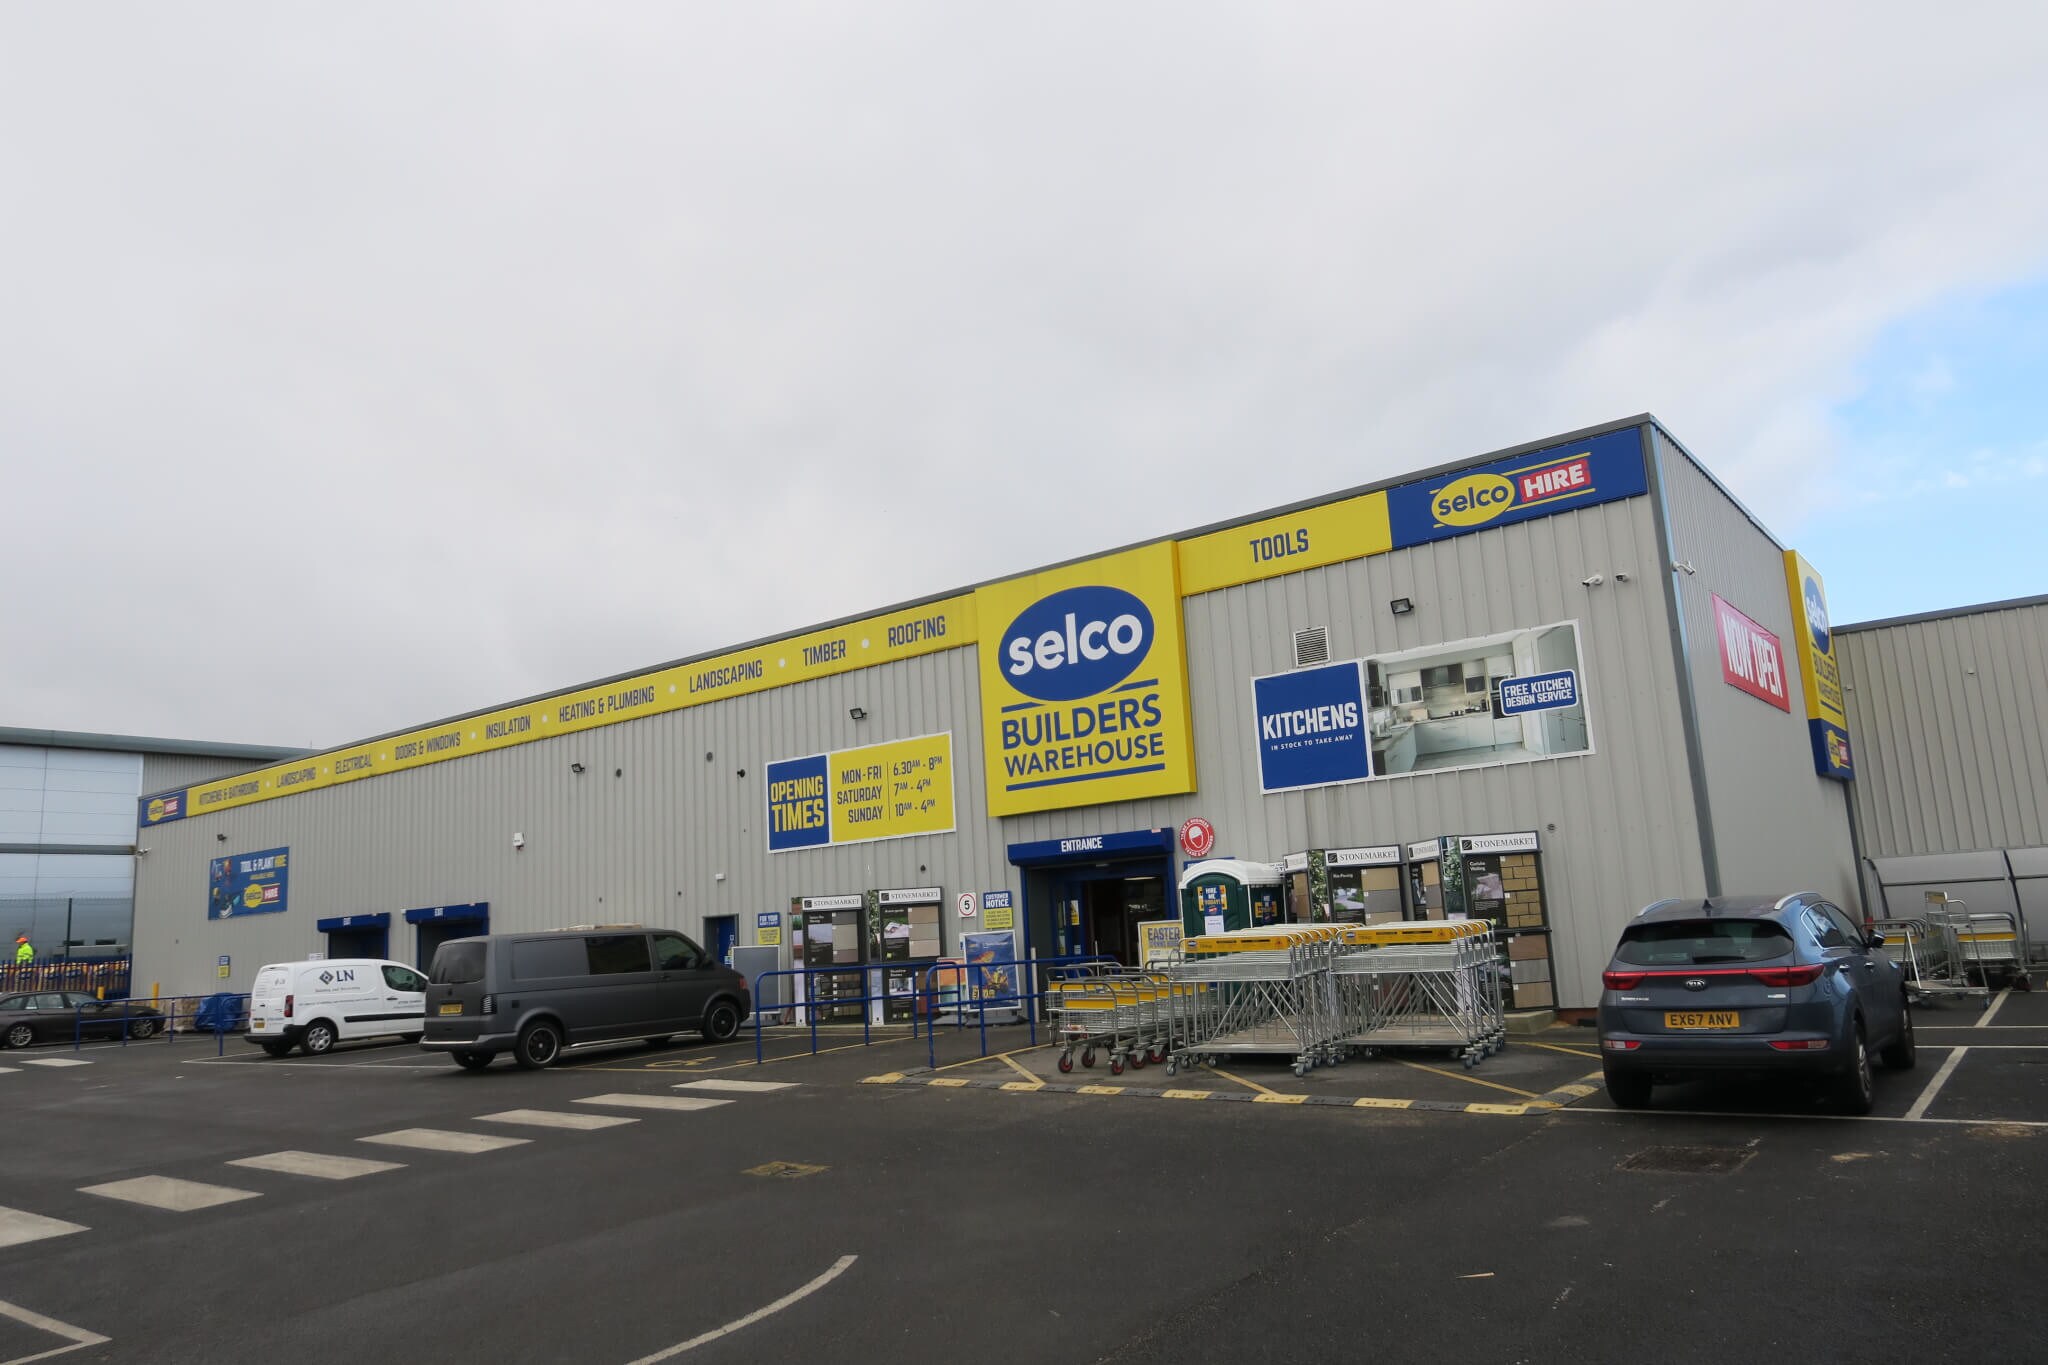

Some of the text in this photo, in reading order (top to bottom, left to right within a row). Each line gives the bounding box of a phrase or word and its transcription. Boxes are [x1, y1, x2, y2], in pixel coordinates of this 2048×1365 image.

[1438, 464, 1586, 517] selco HIRE
[1250, 528, 1308, 563] TOOLS
[888, 615, 945, 648] ROOFING
[803, 639, 846, 666] TIMBER
[1009, 612, 1143, 676] selco
[1722, 610, 1783, 698] NOW OPEN
[689, 659, 763, 693] LANDSCAPING
[1504, 676, 1572, 697] FREE KITCHEN
[559, 686, 655, 723] HEATING & PLUMBING
[1506, 689, 1573, 708] DESIGN SERVICE
[485, 715, 531, 740] INSULATION
[1001, 693, 1162, 750] BUILDERS
[1262, 702, 1358, 740] KITCHENS
[395, 732, 461, 760] DOORS & WINDOWS
[1280, 742, 1301, 750] STOCK
[1315, 737, 1332, 745] TAKE
[1334, 734, 1353, 742] AWAY
[336, 754, 372, 774] ELECTRICAL
[929, 756, 942, 771] 8PM
[1004, 732, 1165, 777] WAREHOUSE
[276, 767, 316, 788] LANDSCAPING
[894, 782, 908, 796] 7AM
[917, 777, 931, 792] 4PM
[770, 776, 824, 802] OPENING
[837, 785, 882, 805] SATURDAY
[772, 798, 824, 833] TIMES
[848, 806, 883, 823] SUNDAY
[895, 802, 912, 817] 10AM
[921, 799, 935, 813] 4PM
[1061, 837, 1103, 852] ENTRANCE
[1474, 837, 1534, 848] STONEMARKET
[1340, 851, 1397, 861] STONEMARKET
[813, 898, 859, 907] STONEMARKET
[964, 900, 970, 910] 5
[985, 899, 1009, 908] NOTICE
[1148, 927, 1180, 940] EASTER
[336, 969, 354, 982] LN
[1670, 1013, 1734, 1026] EX67 ANV
